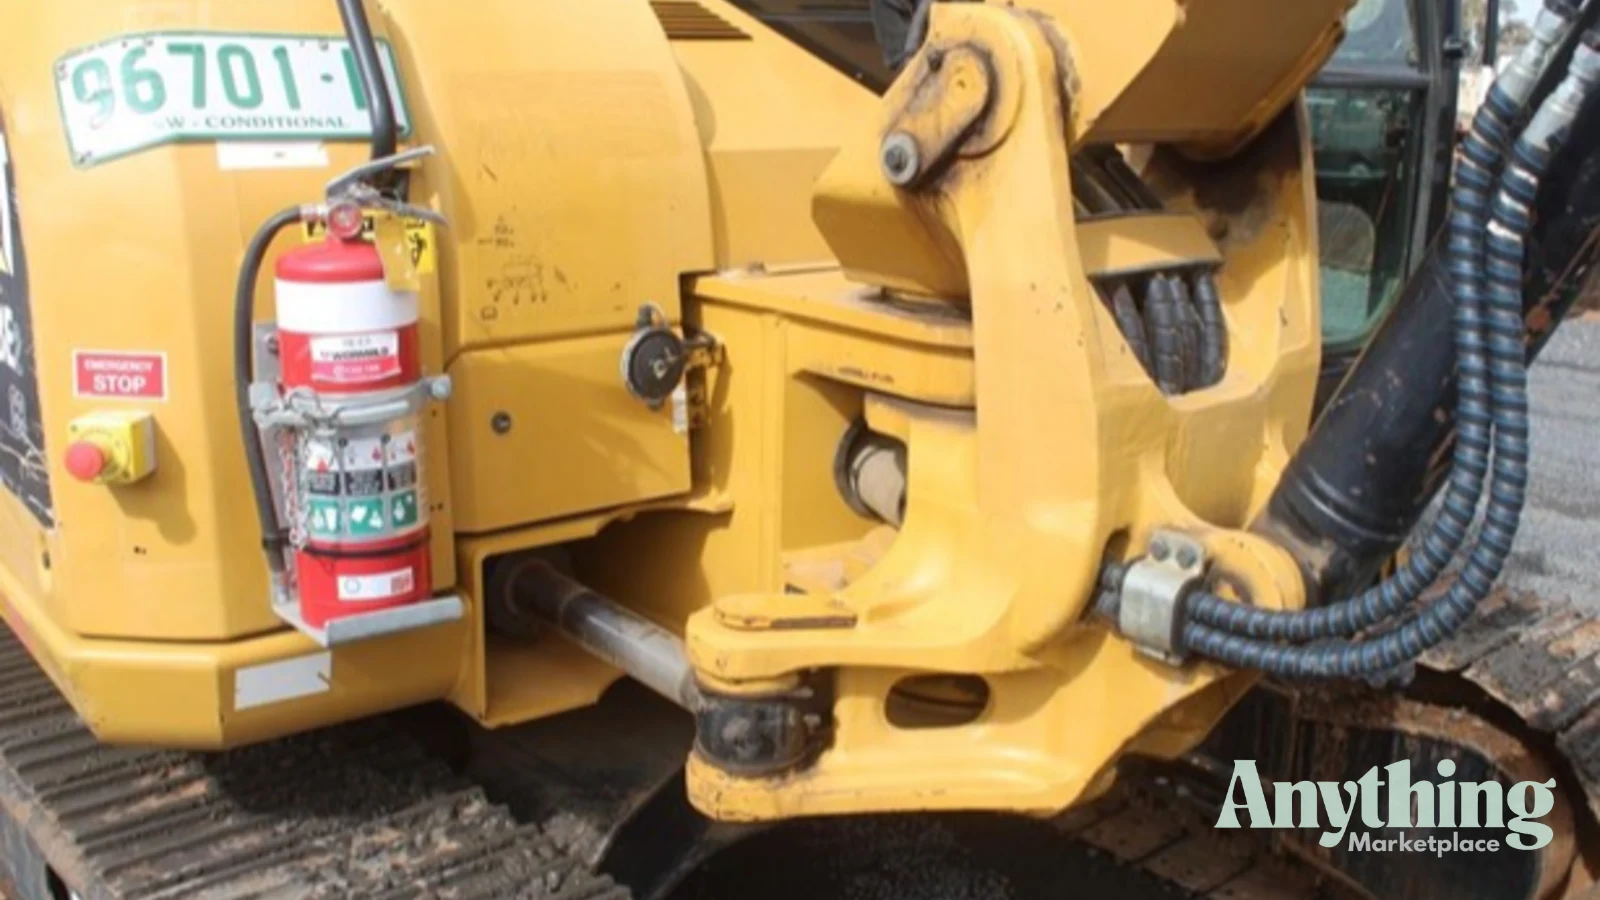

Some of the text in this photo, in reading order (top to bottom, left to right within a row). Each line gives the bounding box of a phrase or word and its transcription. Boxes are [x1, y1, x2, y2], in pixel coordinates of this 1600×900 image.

[204, 115, 350, 129] CONDITIONAL
[84, 359, 154, 372] EMERGENCY
[93, 374, 147, 393] STOP
